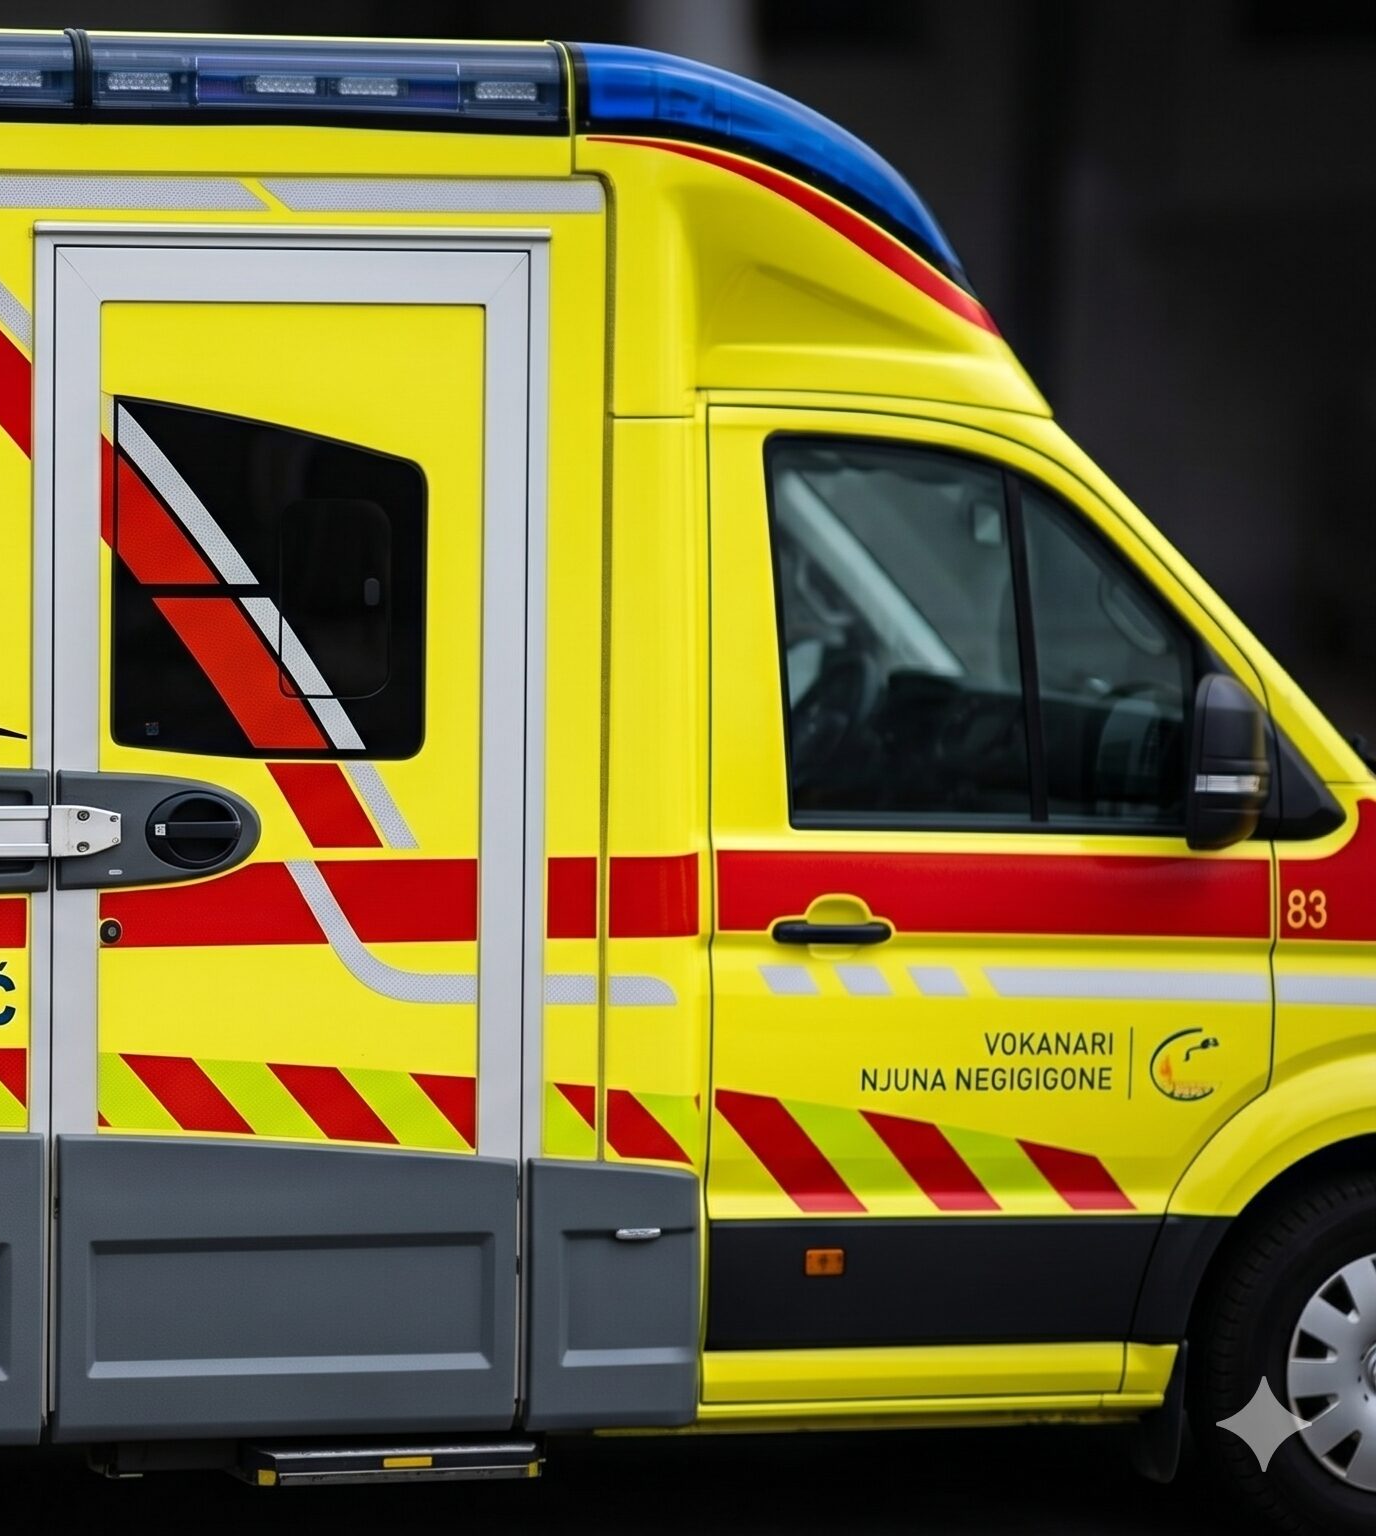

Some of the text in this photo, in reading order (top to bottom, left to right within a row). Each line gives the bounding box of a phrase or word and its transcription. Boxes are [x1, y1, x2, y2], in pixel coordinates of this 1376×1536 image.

[1287, 888, 1328, 930] 83
[984, 1032, 1114, 1056] VOKANARI
[861, 1067, 1113, 1092] NJUNA NEGIGIGONE
